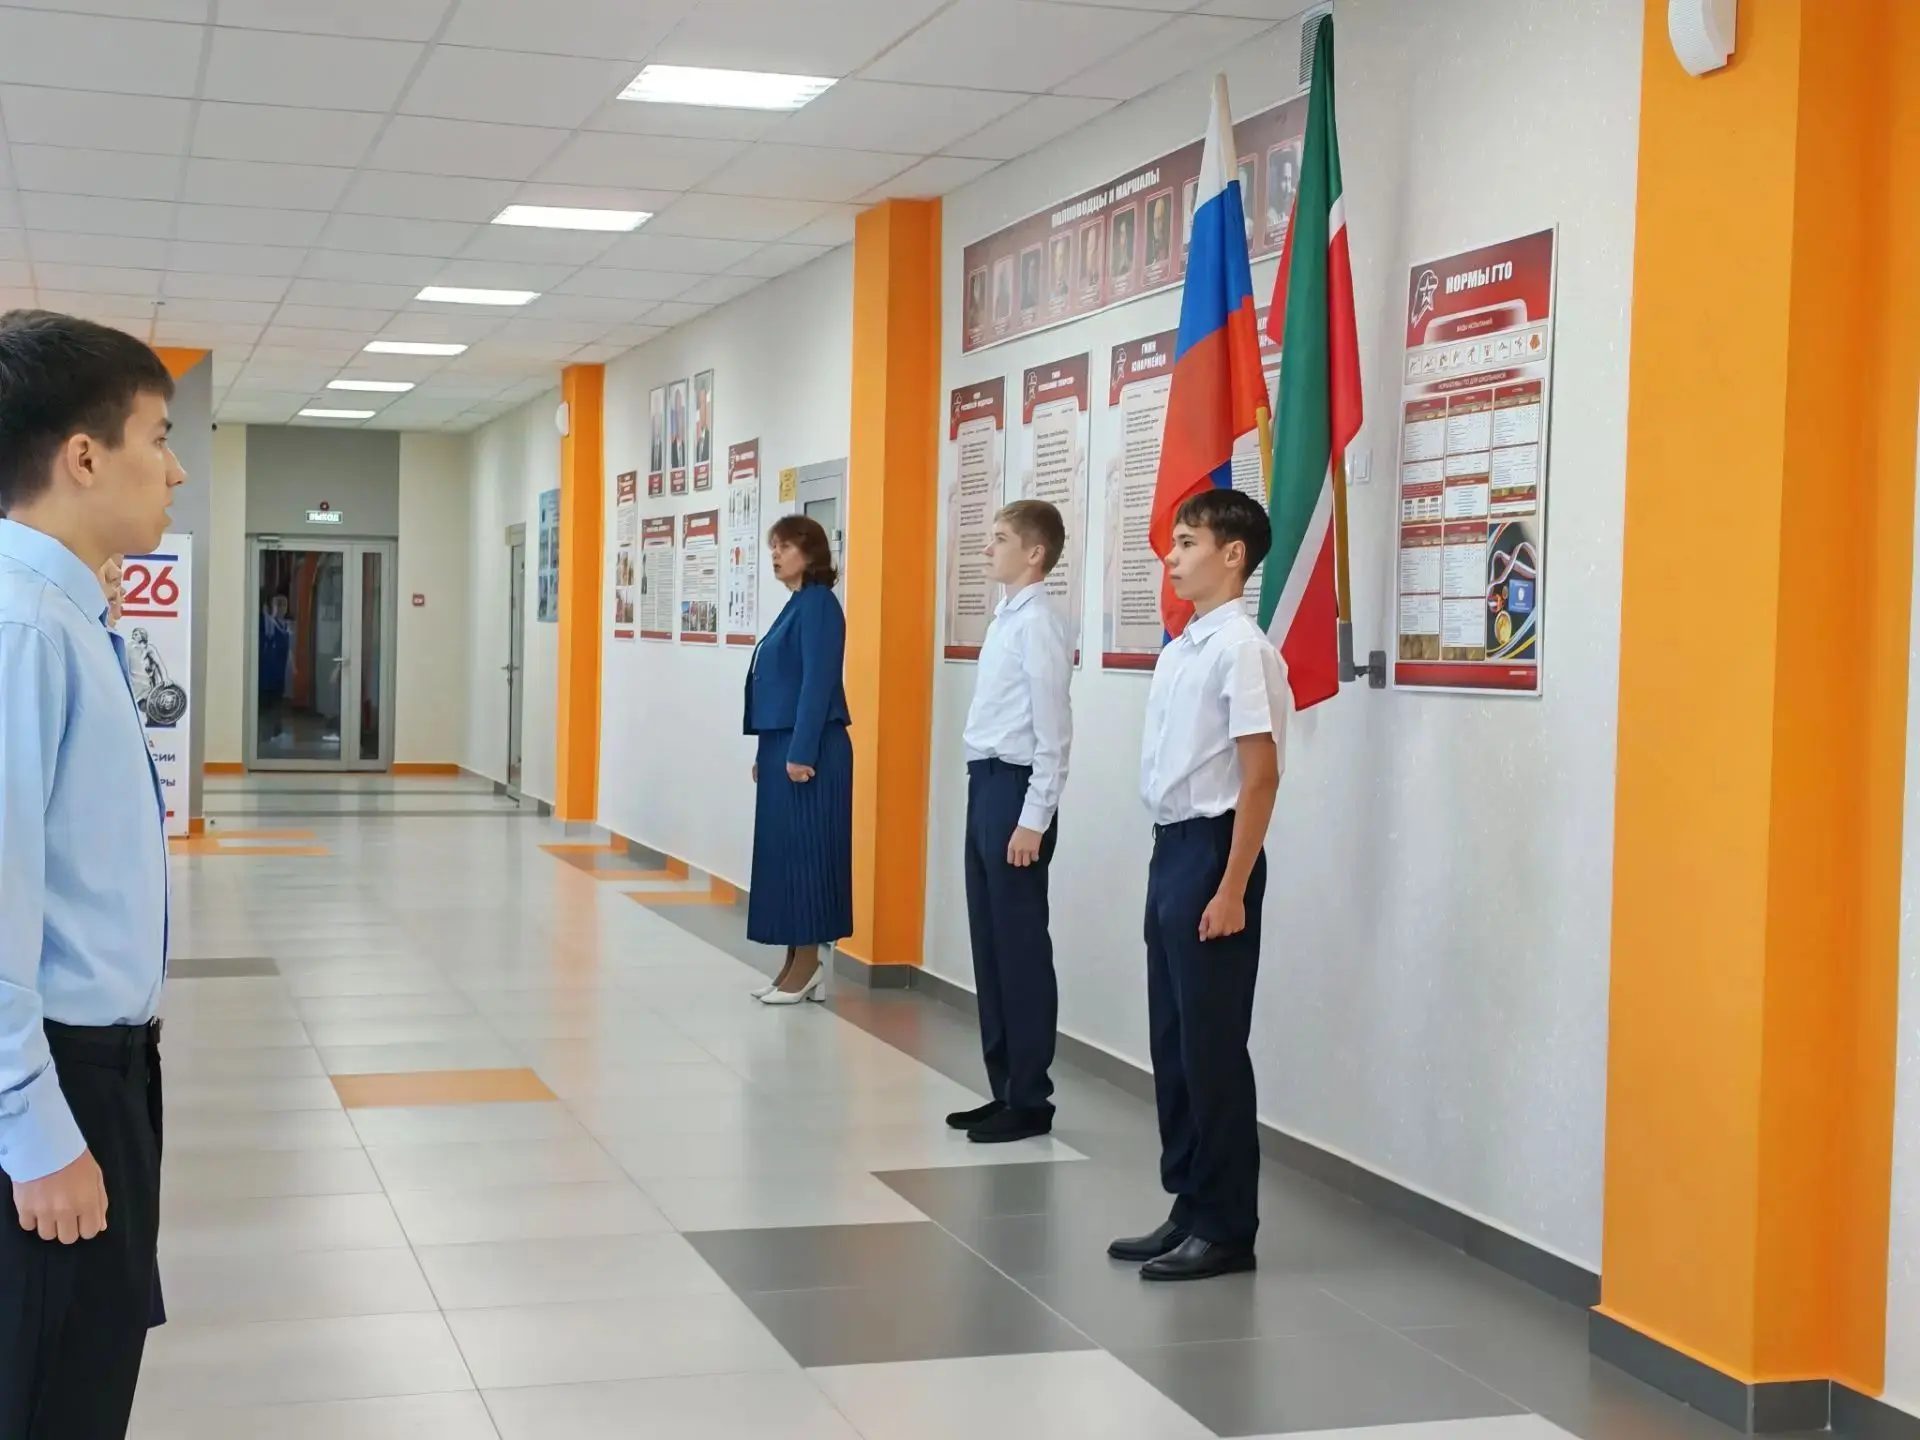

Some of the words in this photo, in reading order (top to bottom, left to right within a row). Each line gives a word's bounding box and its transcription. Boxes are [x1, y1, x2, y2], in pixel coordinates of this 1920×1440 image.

[1115, 167, 1160, 201] МАРШАЛЫ
[1446, 266, 1490, 294] НОРМЫ
[1491, 260, 1513, 283] ГТО
[308, 512, 340, 522] ВЫХОД
[123, 564, 179, 606] 26
[152, 753, 176, 762] СИИ
